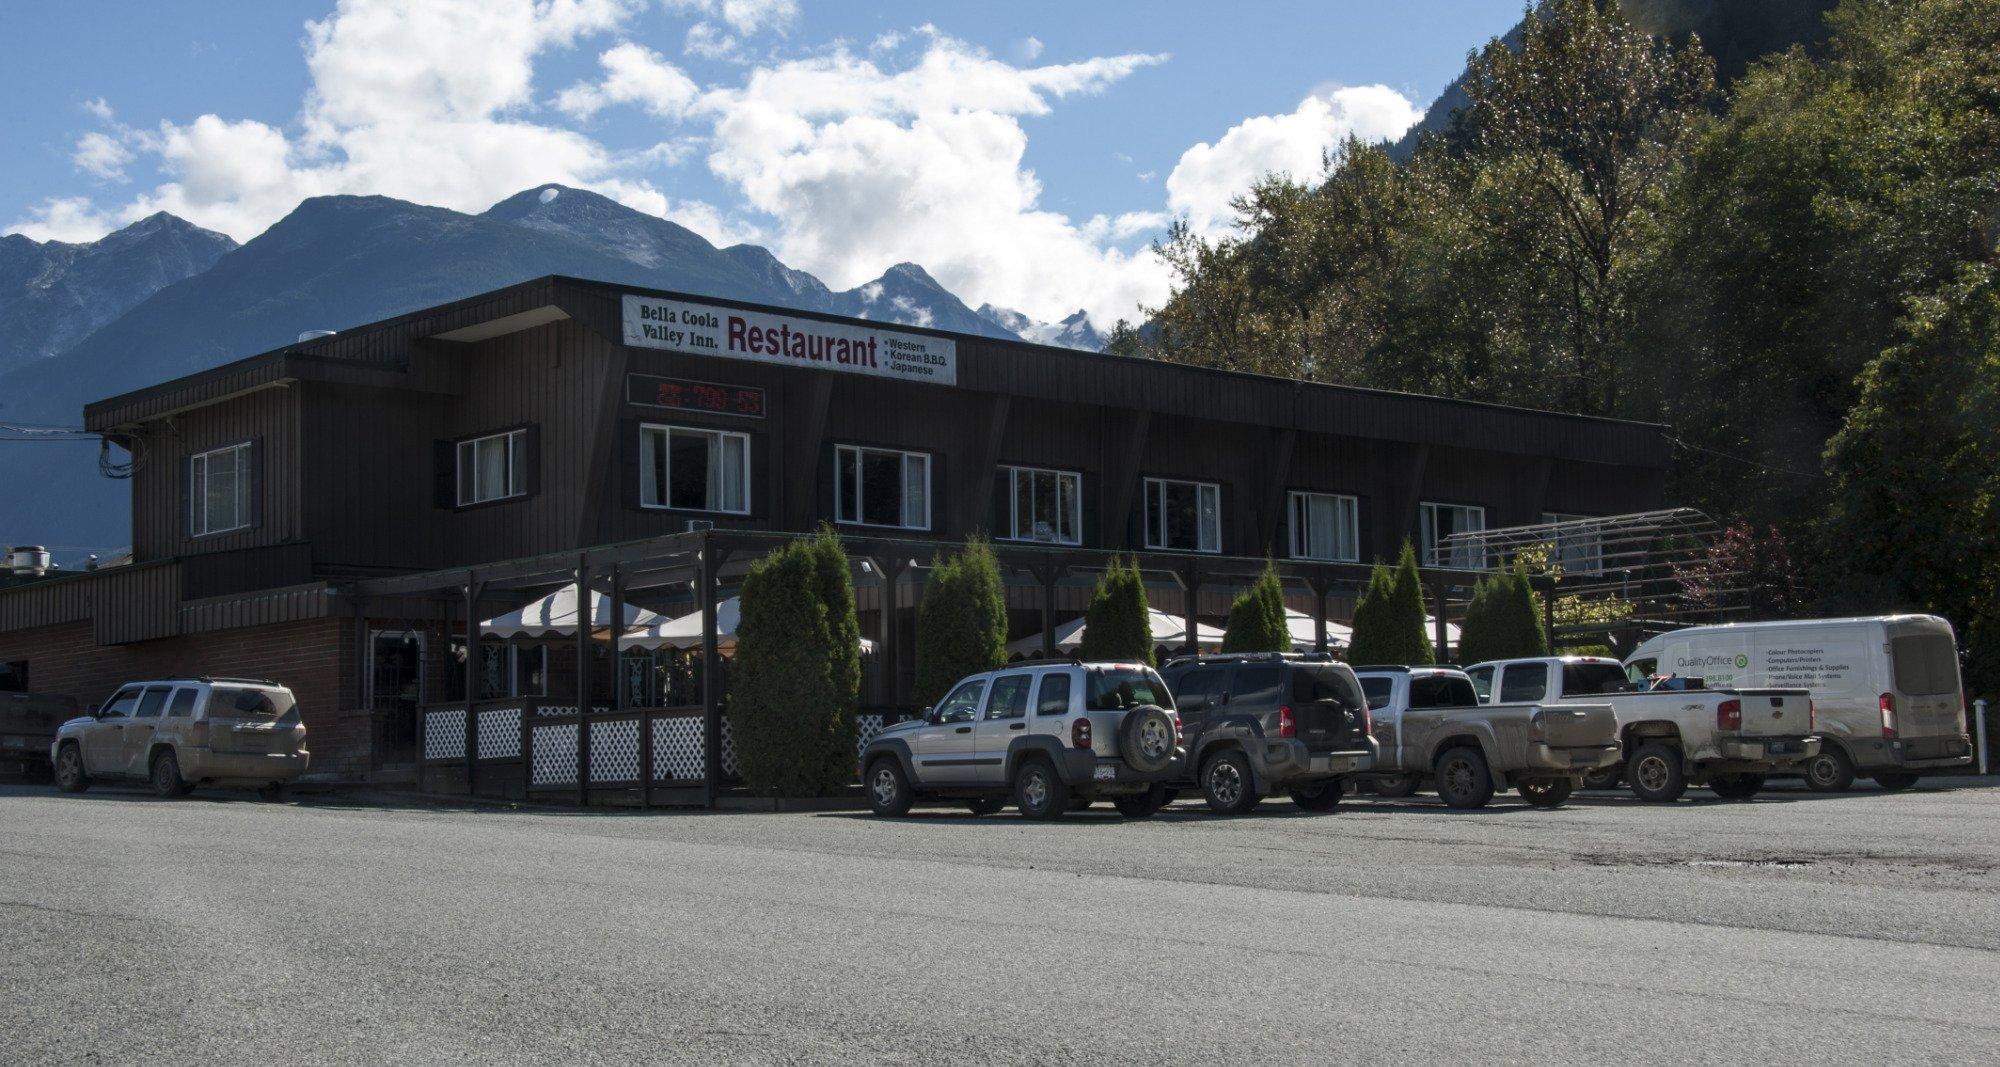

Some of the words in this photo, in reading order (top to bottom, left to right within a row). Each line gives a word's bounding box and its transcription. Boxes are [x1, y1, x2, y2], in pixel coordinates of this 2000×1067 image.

[640, 304, 676, 323] Bella
[681, 310, 719, 329] Coola
[642, 323, 684, 347] Valley
[728, 315, 878, 369] Restaurant
[888, 338, 926, 353] Western
[890, 349, 922, 363] Korean
[890, 362, 934, 376] Japanese
